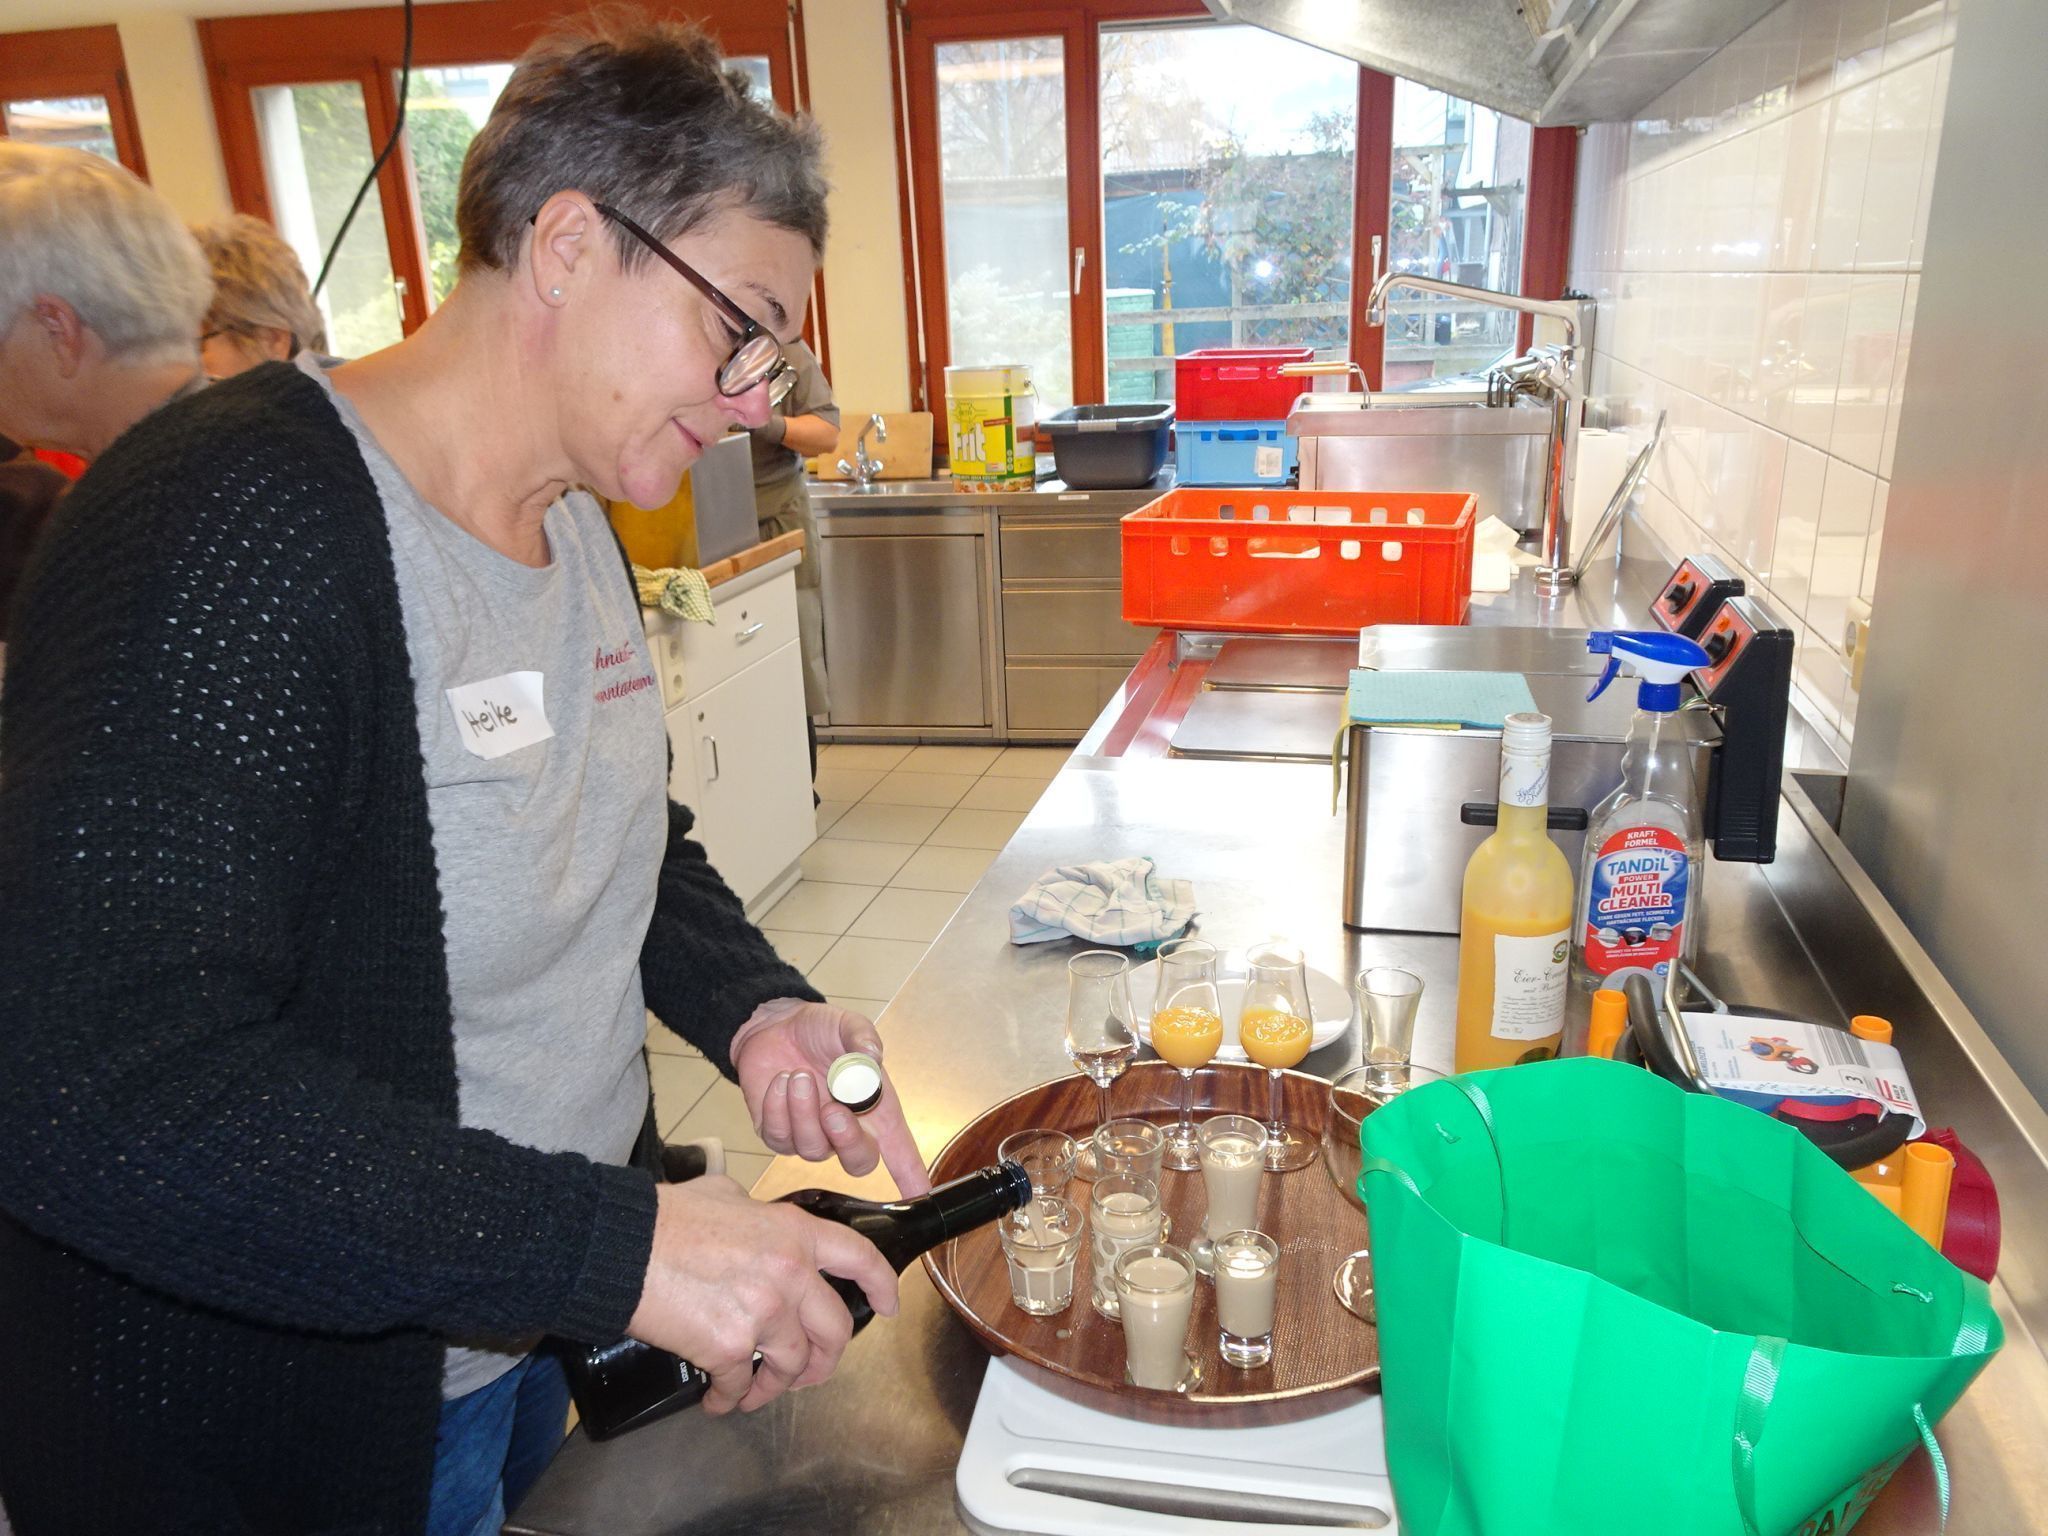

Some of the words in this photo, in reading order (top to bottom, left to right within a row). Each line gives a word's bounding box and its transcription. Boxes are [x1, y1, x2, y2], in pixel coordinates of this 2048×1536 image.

[952, 422, 986, 462] Frit
[461, 700, 518, 738] Heike
[1624, 838, 1659, 848] FORMEL
[1627, 830, 1658, 840] KRAFT-
[1624, 874, 1654, 882] POWER
[1612, 883, 1661, 899] MULTI
[1600, 895, 1670, 911] CLEANER
